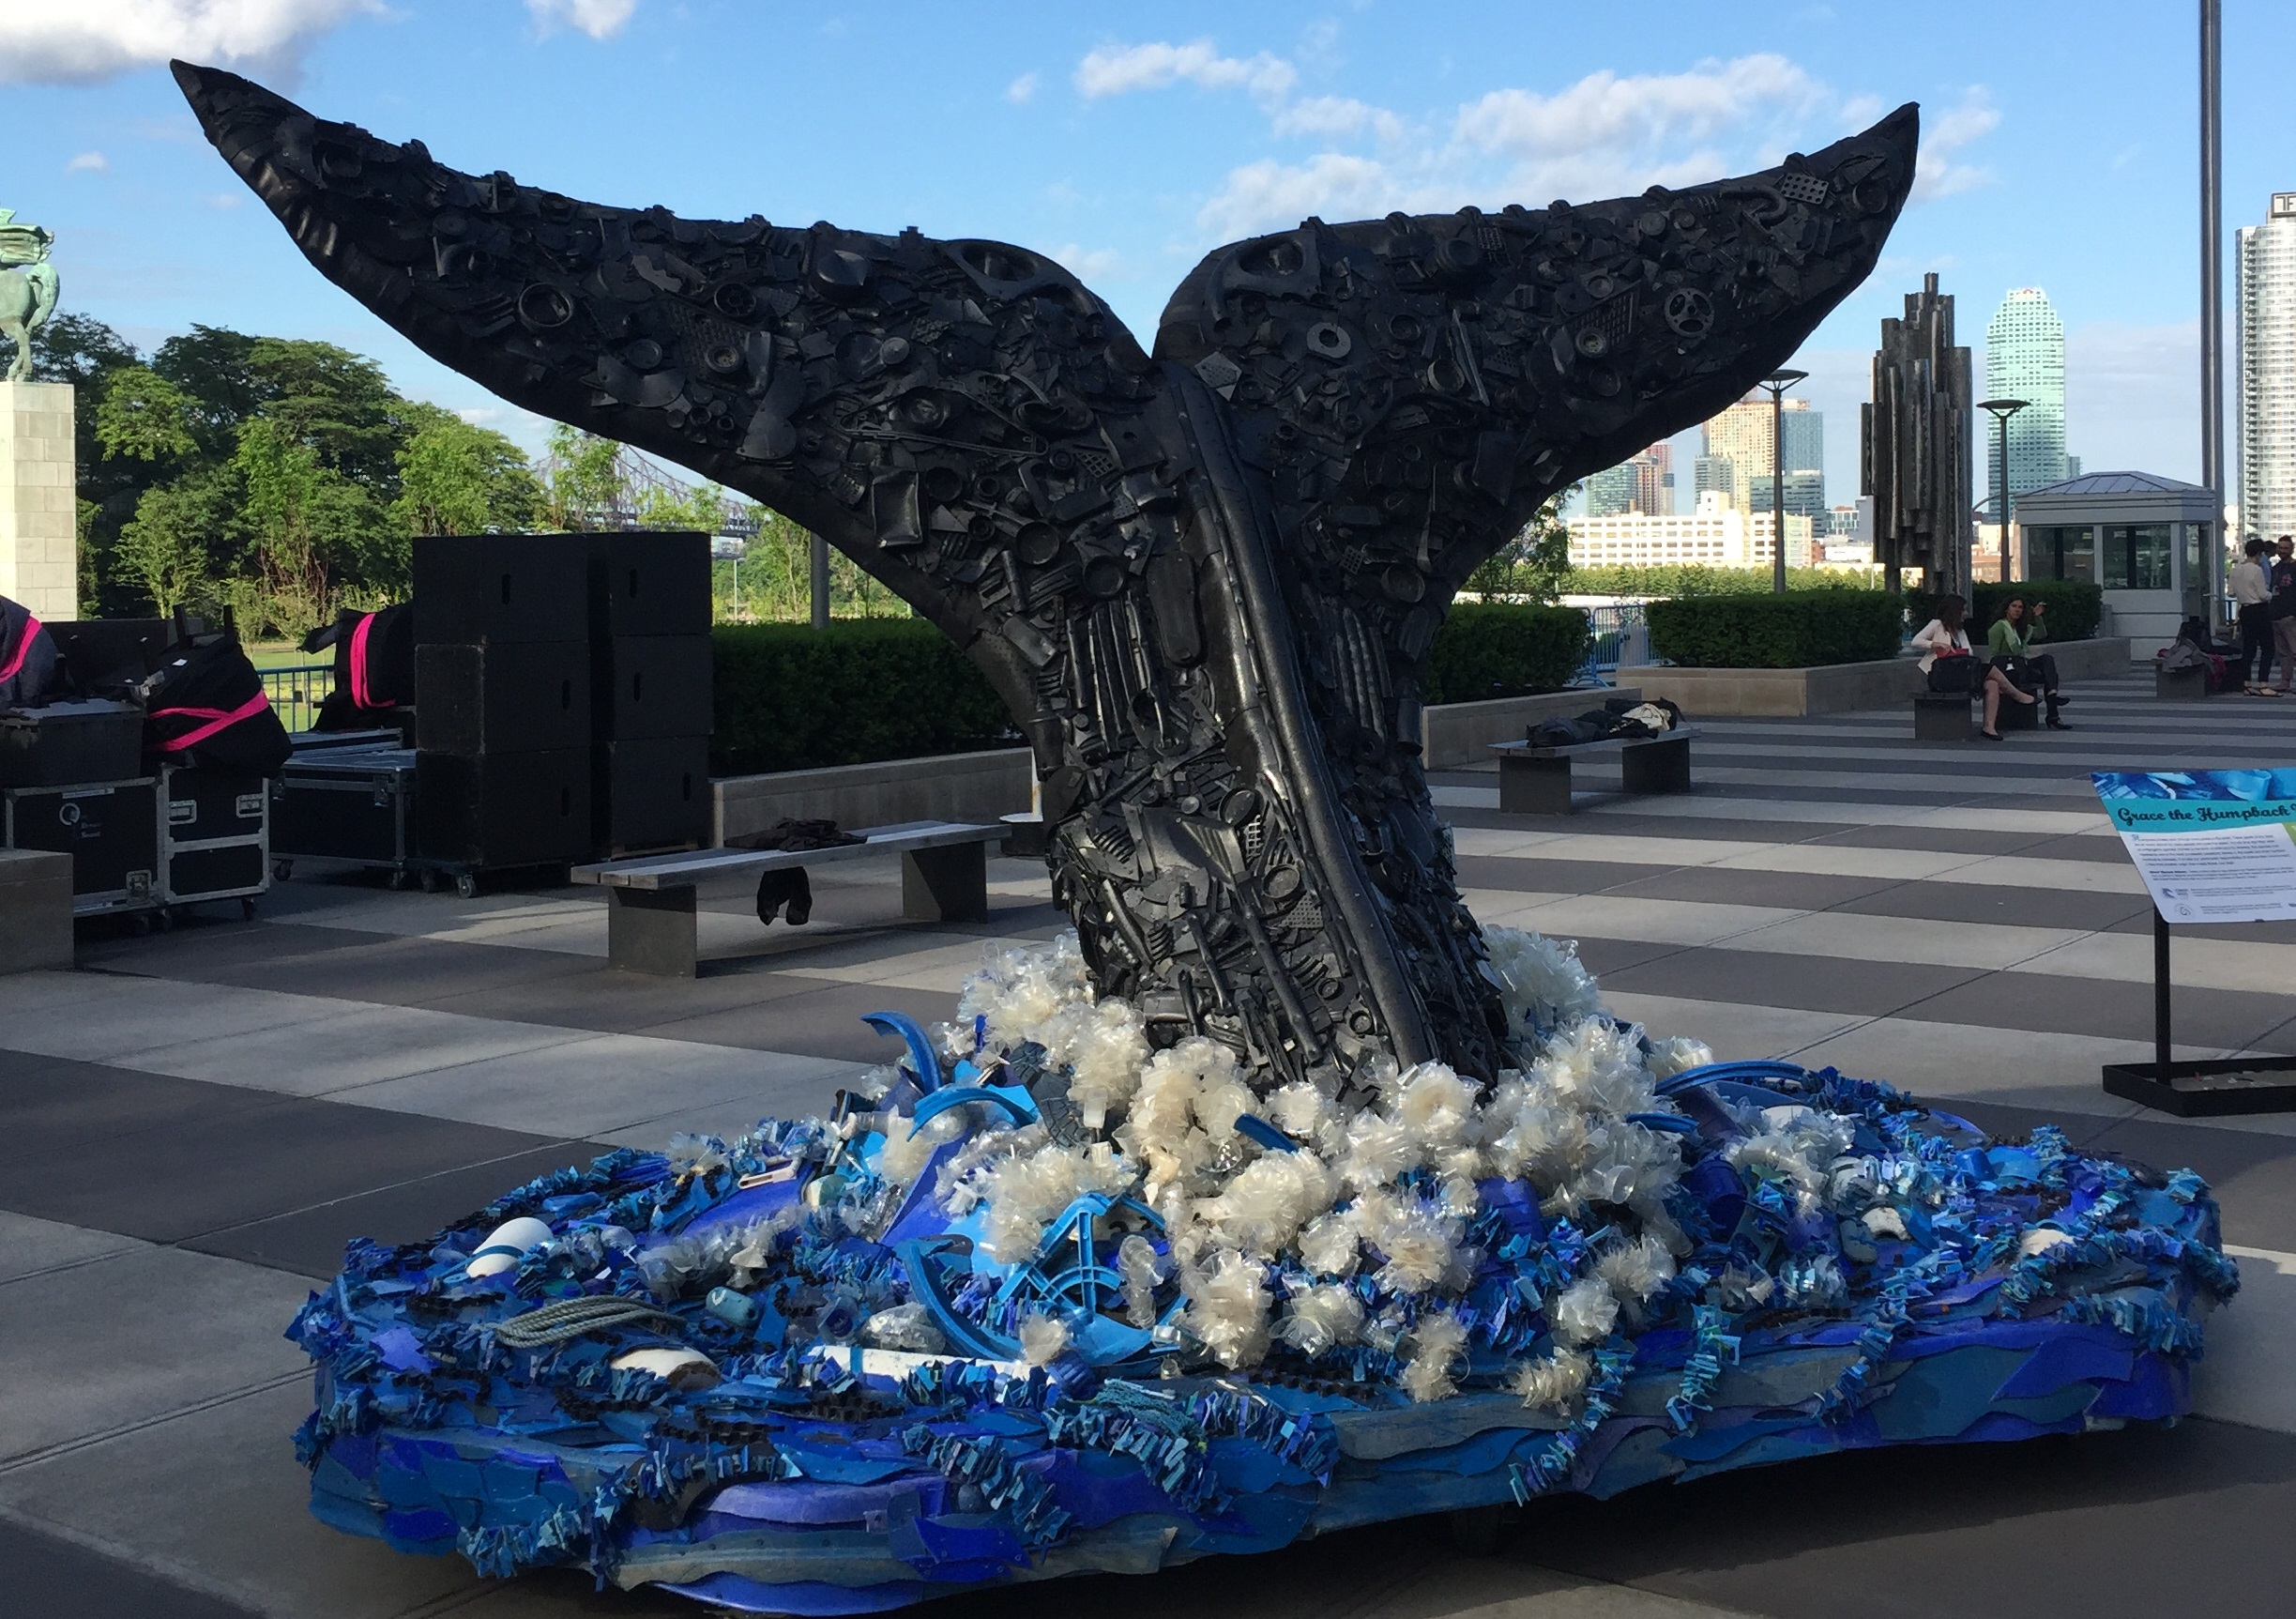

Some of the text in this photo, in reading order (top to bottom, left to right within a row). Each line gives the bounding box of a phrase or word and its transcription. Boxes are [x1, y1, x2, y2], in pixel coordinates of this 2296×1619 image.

[2118, 808, 2166, 826] Grace
[2168, 809, 2194, 820] the
[2197, 805, 2290, 822] Humpback
